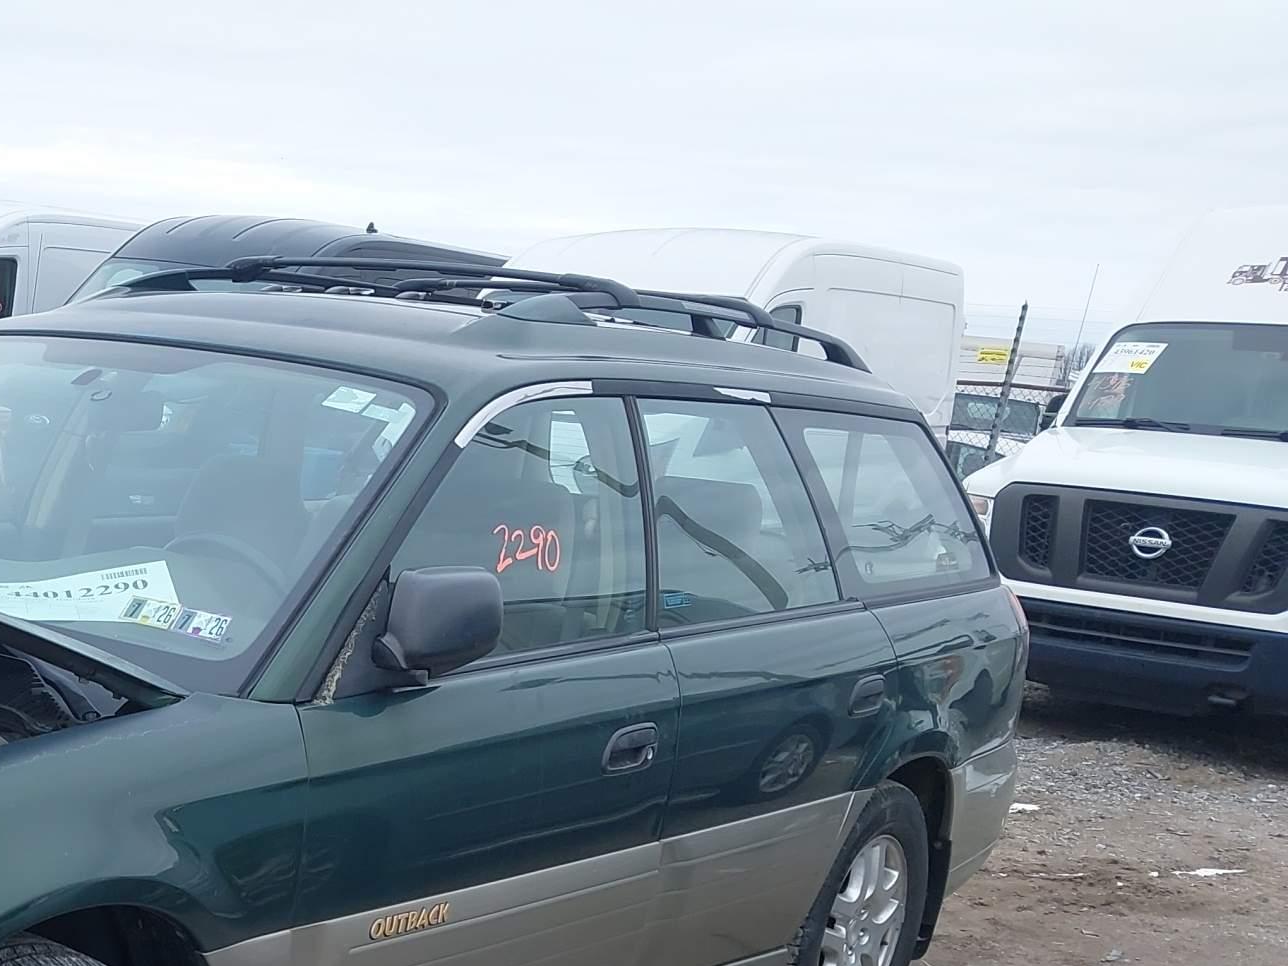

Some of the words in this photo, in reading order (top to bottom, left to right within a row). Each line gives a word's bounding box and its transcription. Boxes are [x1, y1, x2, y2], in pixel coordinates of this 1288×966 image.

[492, 524, 560, 573] 2290
[1133, 538, 1168, 547] NISSAN
[7, 578, 148, 599] 44012290
[156, 606, 176, 624] 26
[208, 618, 228, 637] 26
[369, 902, 449, 940] OUTBACK
